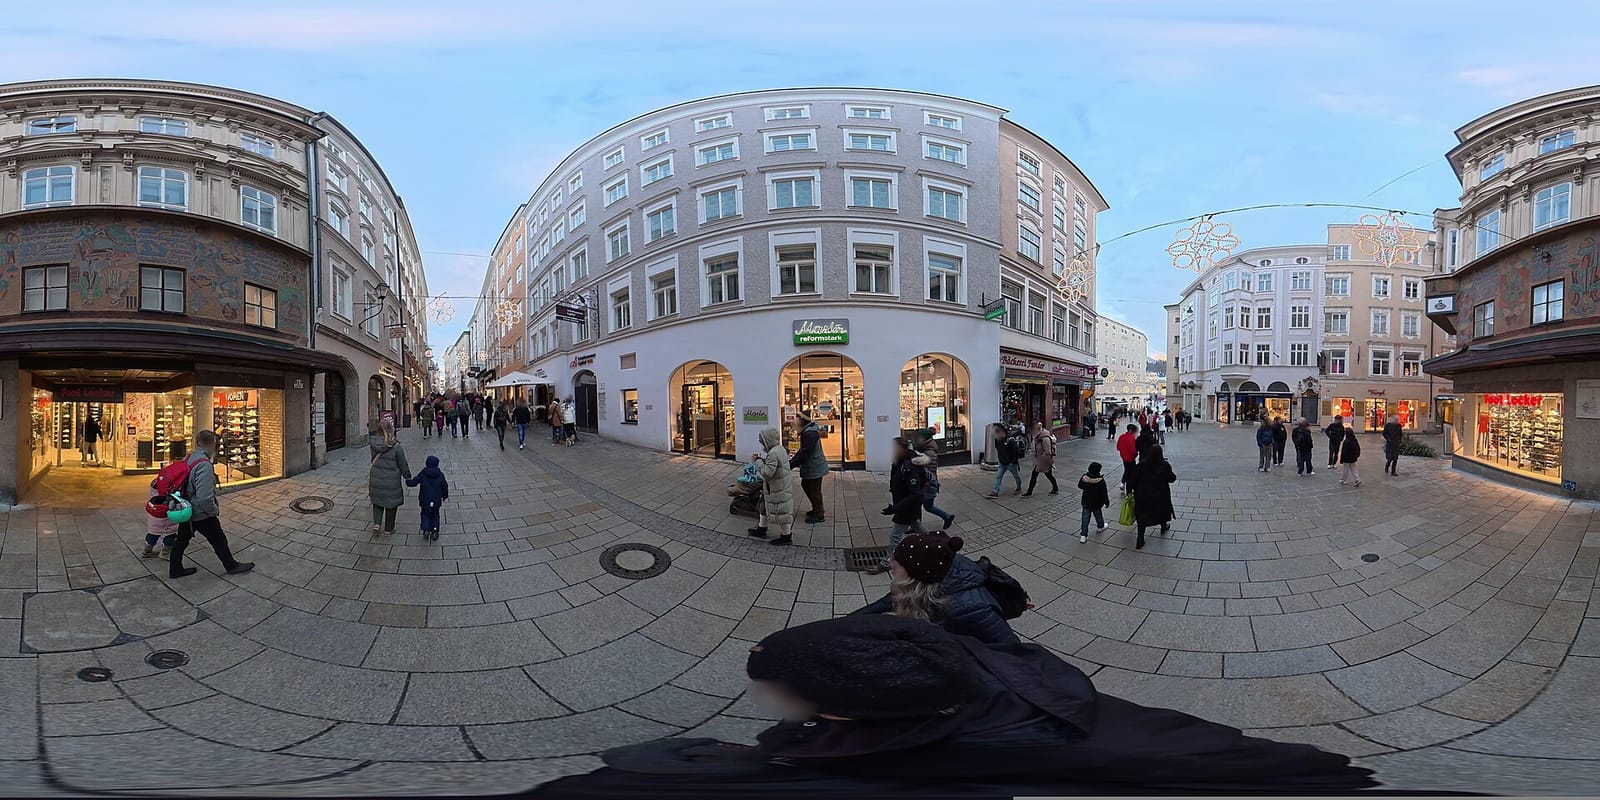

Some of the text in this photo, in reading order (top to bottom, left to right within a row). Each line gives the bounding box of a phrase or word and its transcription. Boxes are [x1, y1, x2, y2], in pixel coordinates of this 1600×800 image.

[799, 334, 843, 343] reformstark
[1484, 392, 1543, 407] Foot Locker
